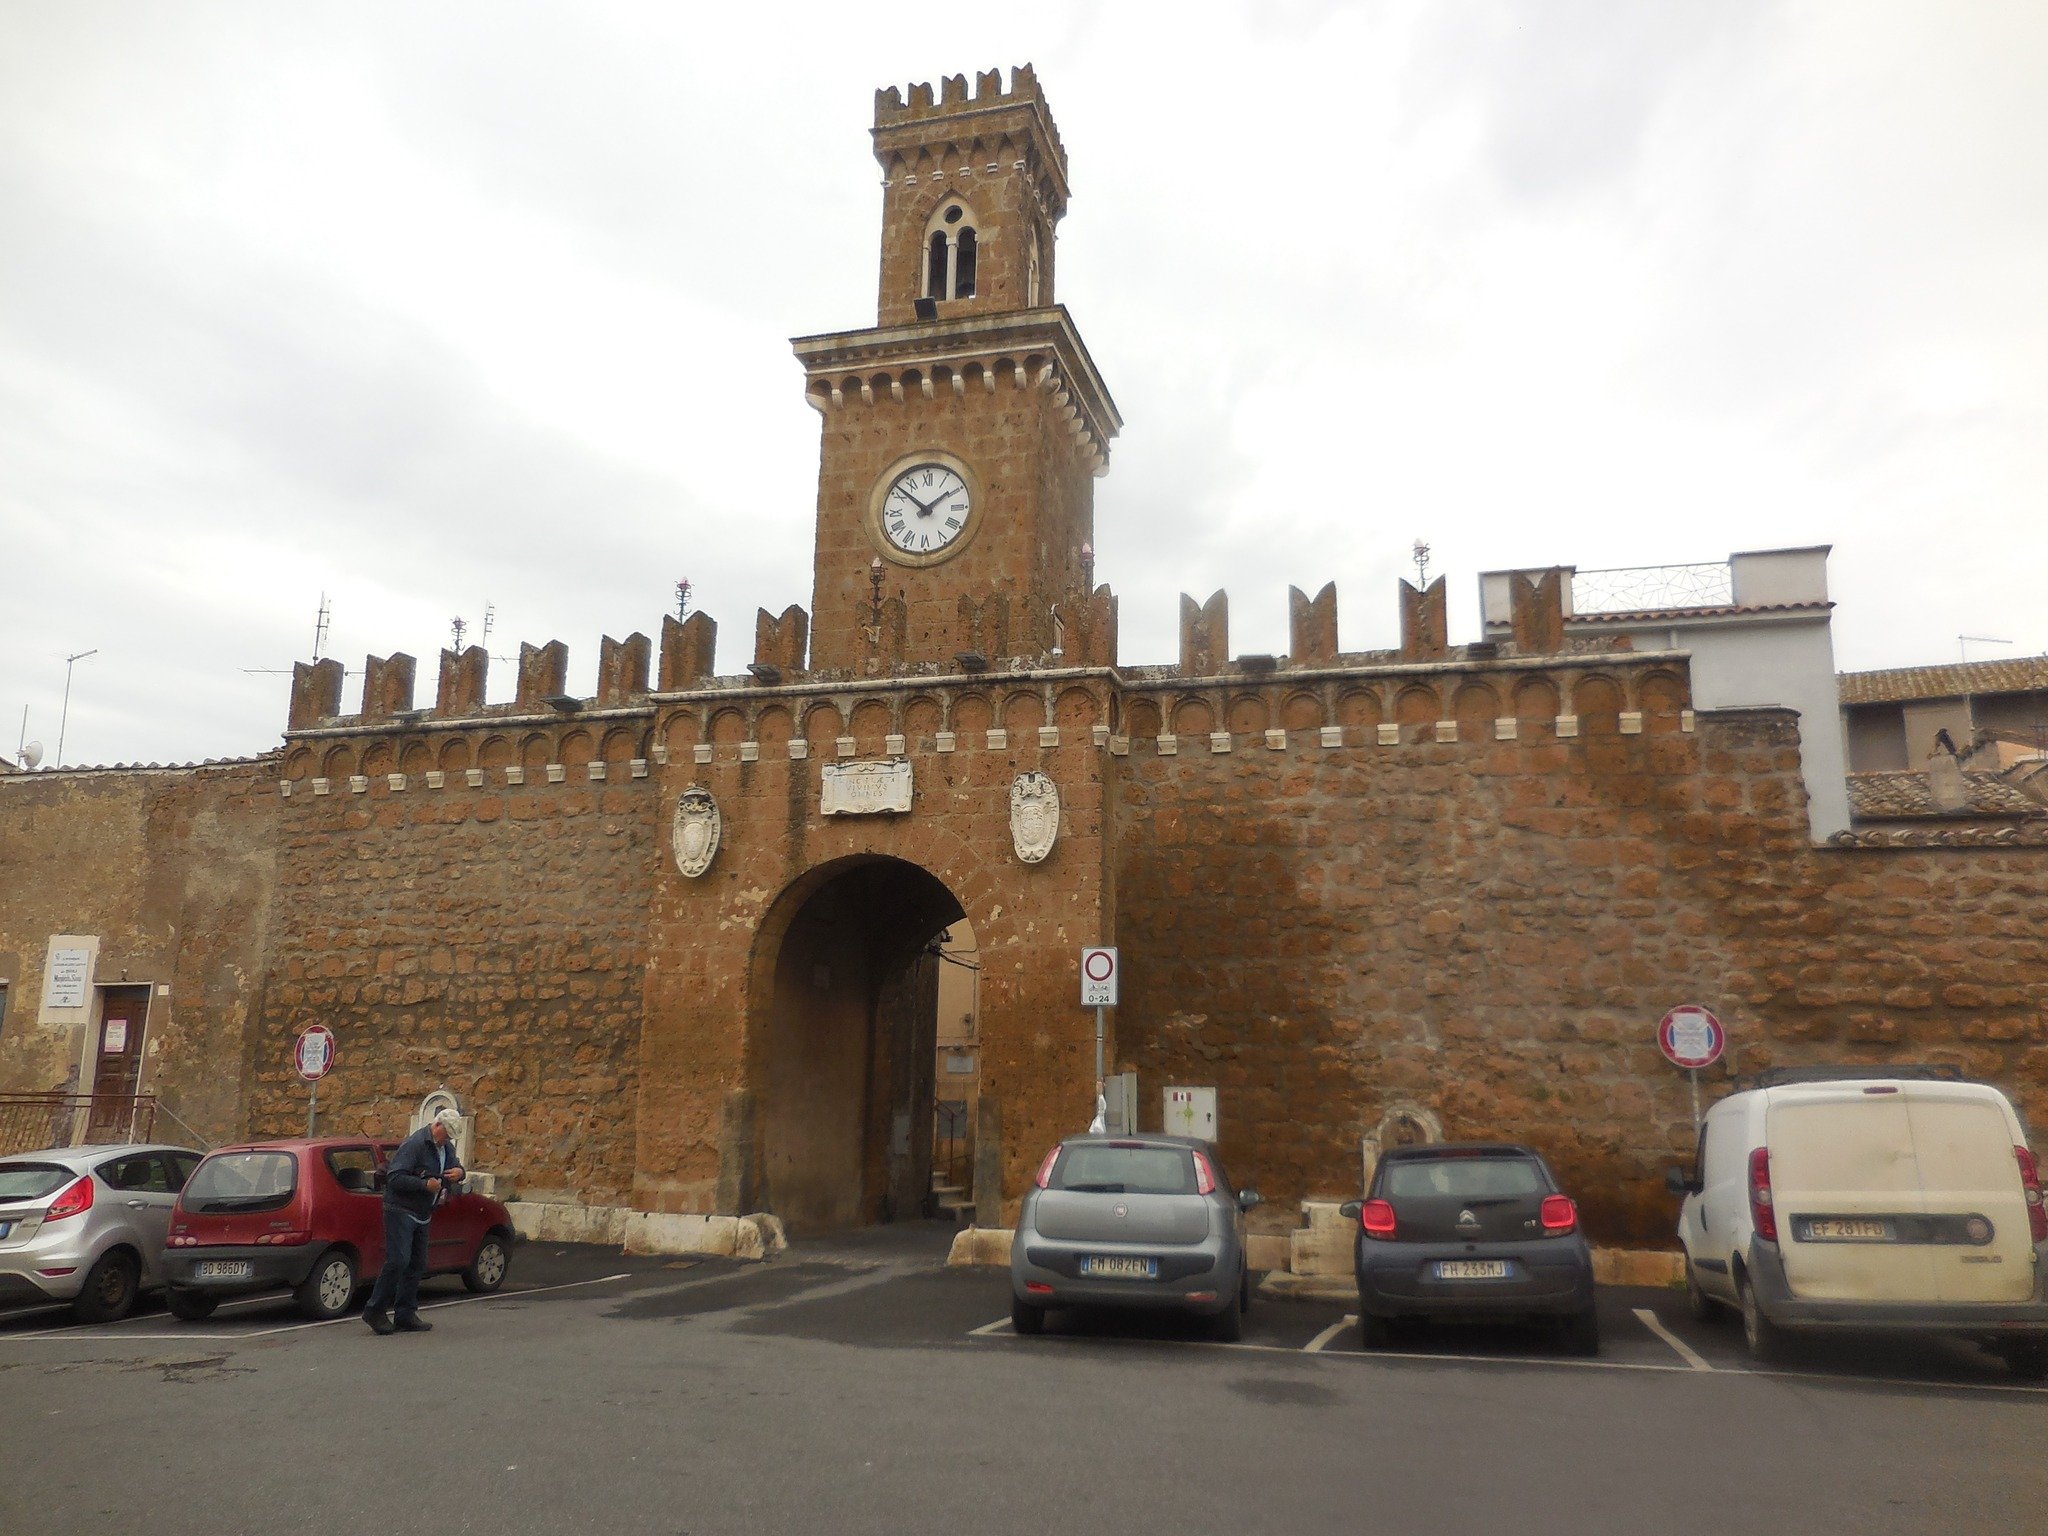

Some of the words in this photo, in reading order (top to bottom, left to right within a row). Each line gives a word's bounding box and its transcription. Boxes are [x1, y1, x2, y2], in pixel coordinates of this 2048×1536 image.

[906, 478, 918, 493] XI
[922, 473, 933, 487] XII
[939, 476, 947, 489] I
[893, 492, 907, 503] X
[889, 508, 903, 517] IX
[891, 519, 906, 537] VIII
[945, 517, 960, 530] IIII
[902, 530, 916, 546] VII
[921, 534, 930, 548] VI
[937, 530, 947, 543] V
[1088, 995, 1110, 1003] 0-24
[216, 1262, 246, 1275] 986DY
